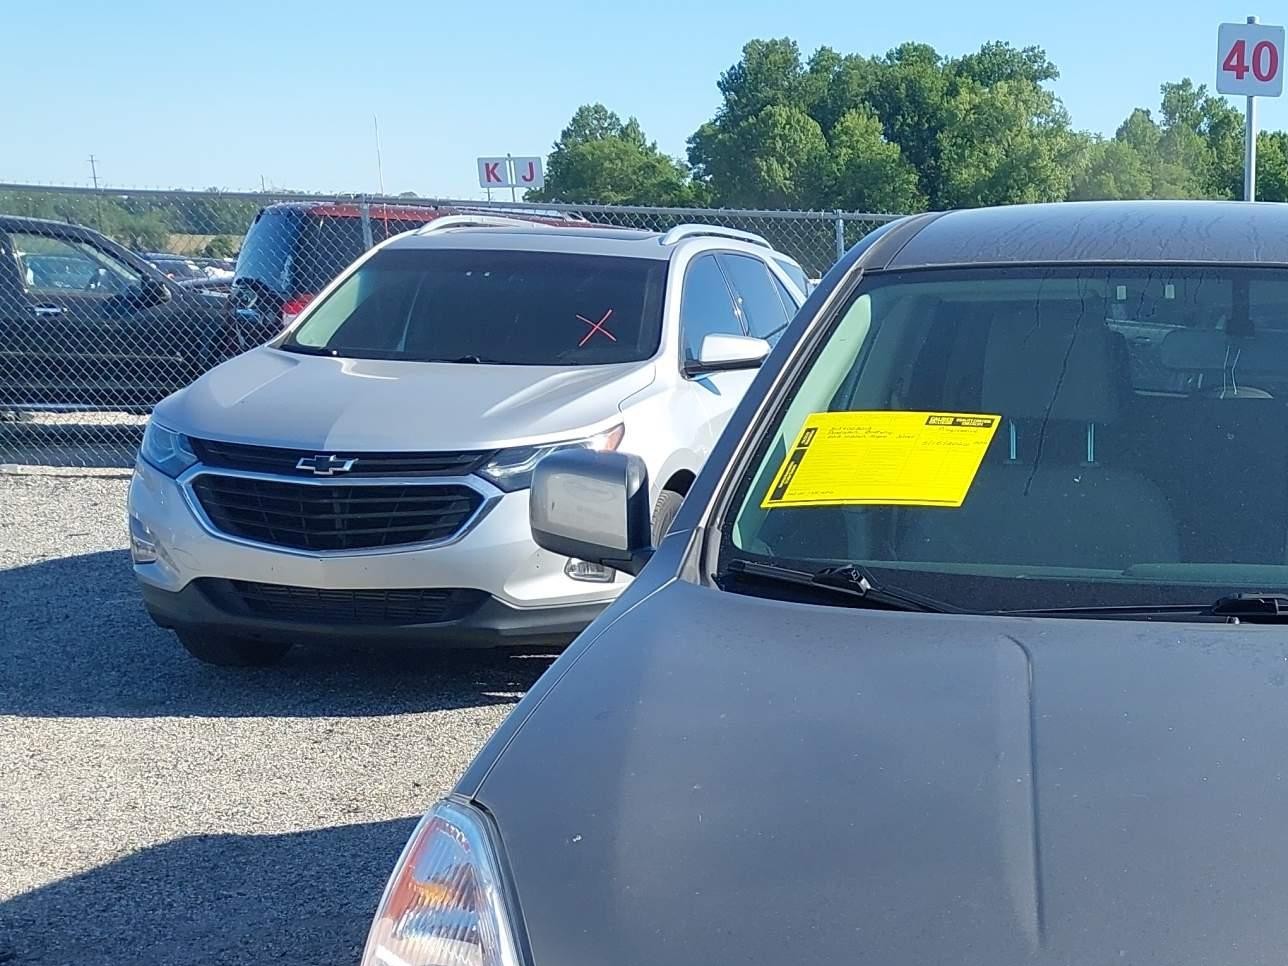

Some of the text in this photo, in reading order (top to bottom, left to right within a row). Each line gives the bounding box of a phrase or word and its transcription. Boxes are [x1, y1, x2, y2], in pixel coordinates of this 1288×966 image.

[1222, 39, 1279, 82] 40
[484, 161, 535, 183] K J
